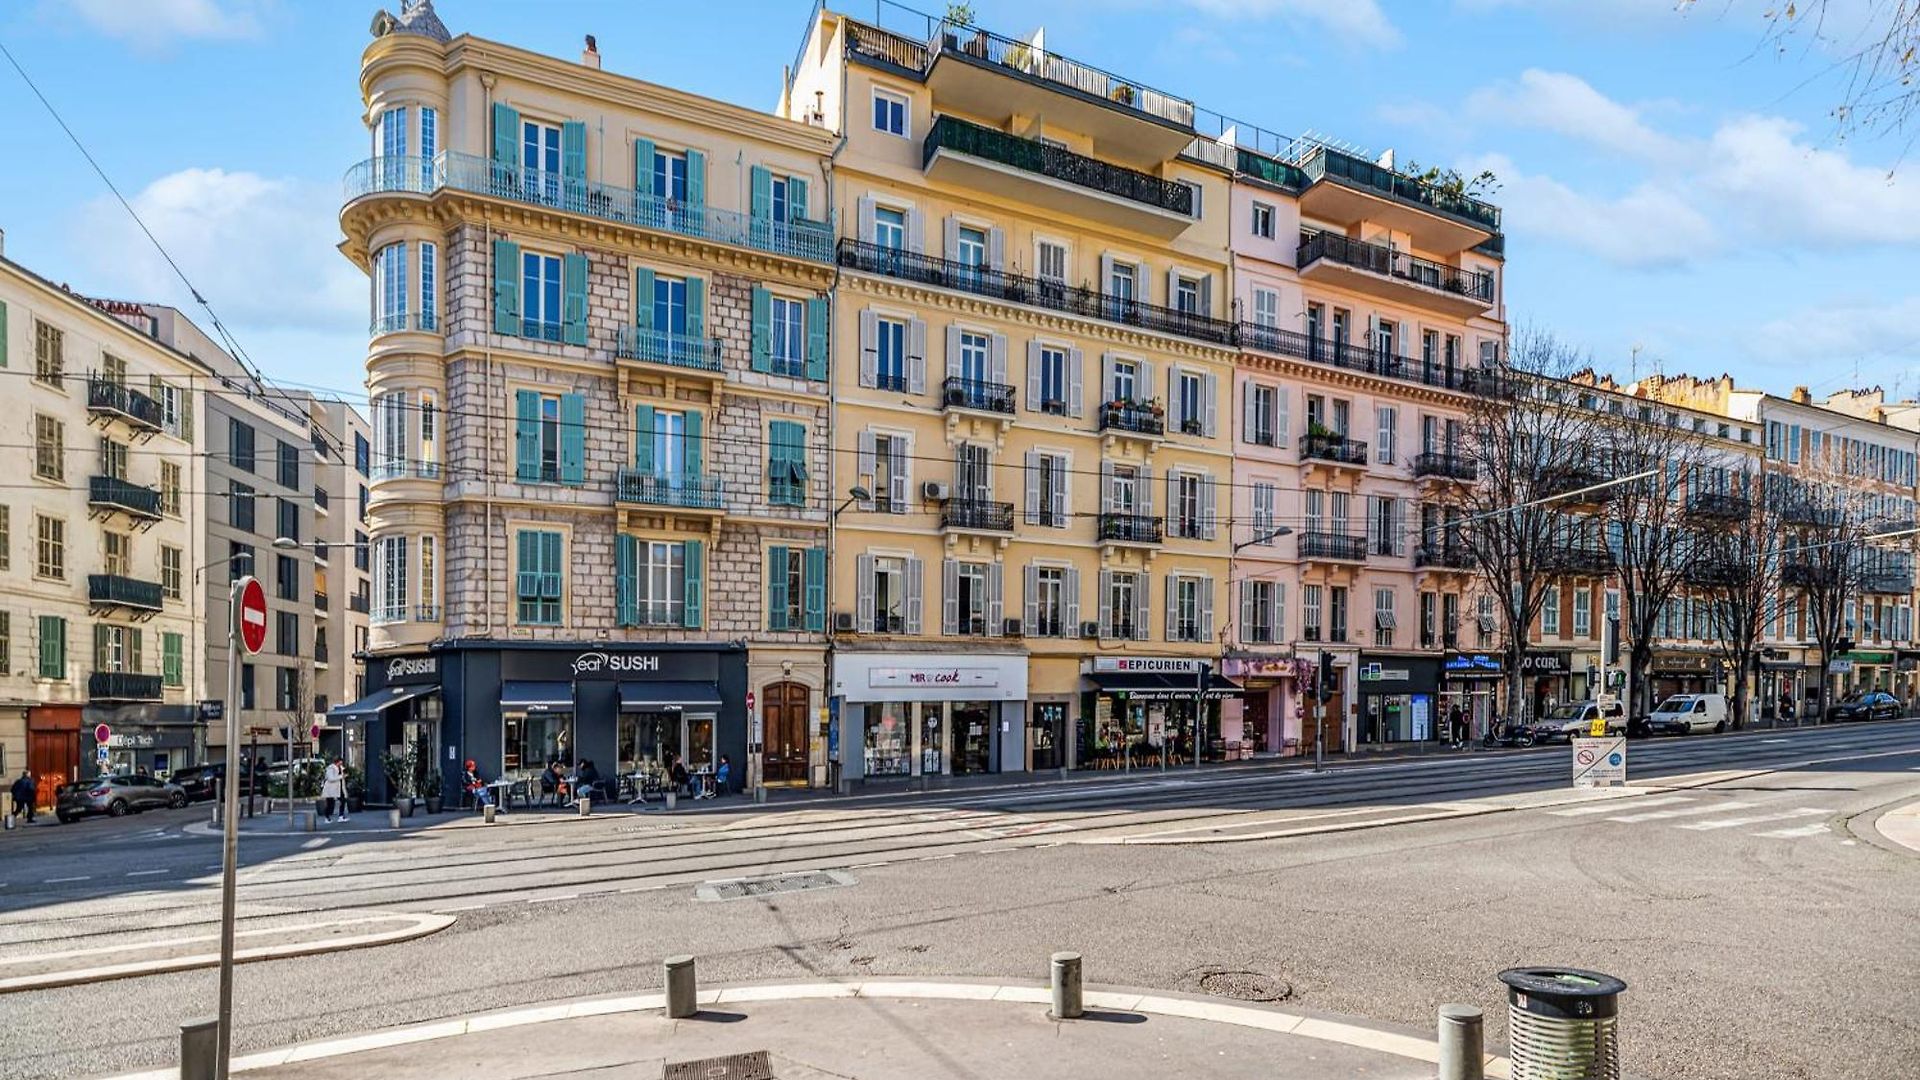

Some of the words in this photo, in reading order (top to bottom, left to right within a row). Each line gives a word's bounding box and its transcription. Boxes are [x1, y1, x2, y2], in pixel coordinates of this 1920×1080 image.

[406, 658, 436, 674] SUSHI
[577, 658, 600, 671] eat
[609, 656, 659, 671] SUSHI
[1128, 660, 1191, 670] EPICURIEN
[1535, 656, 1561, 669] CURL
[935, 668, 960, 683] cook
